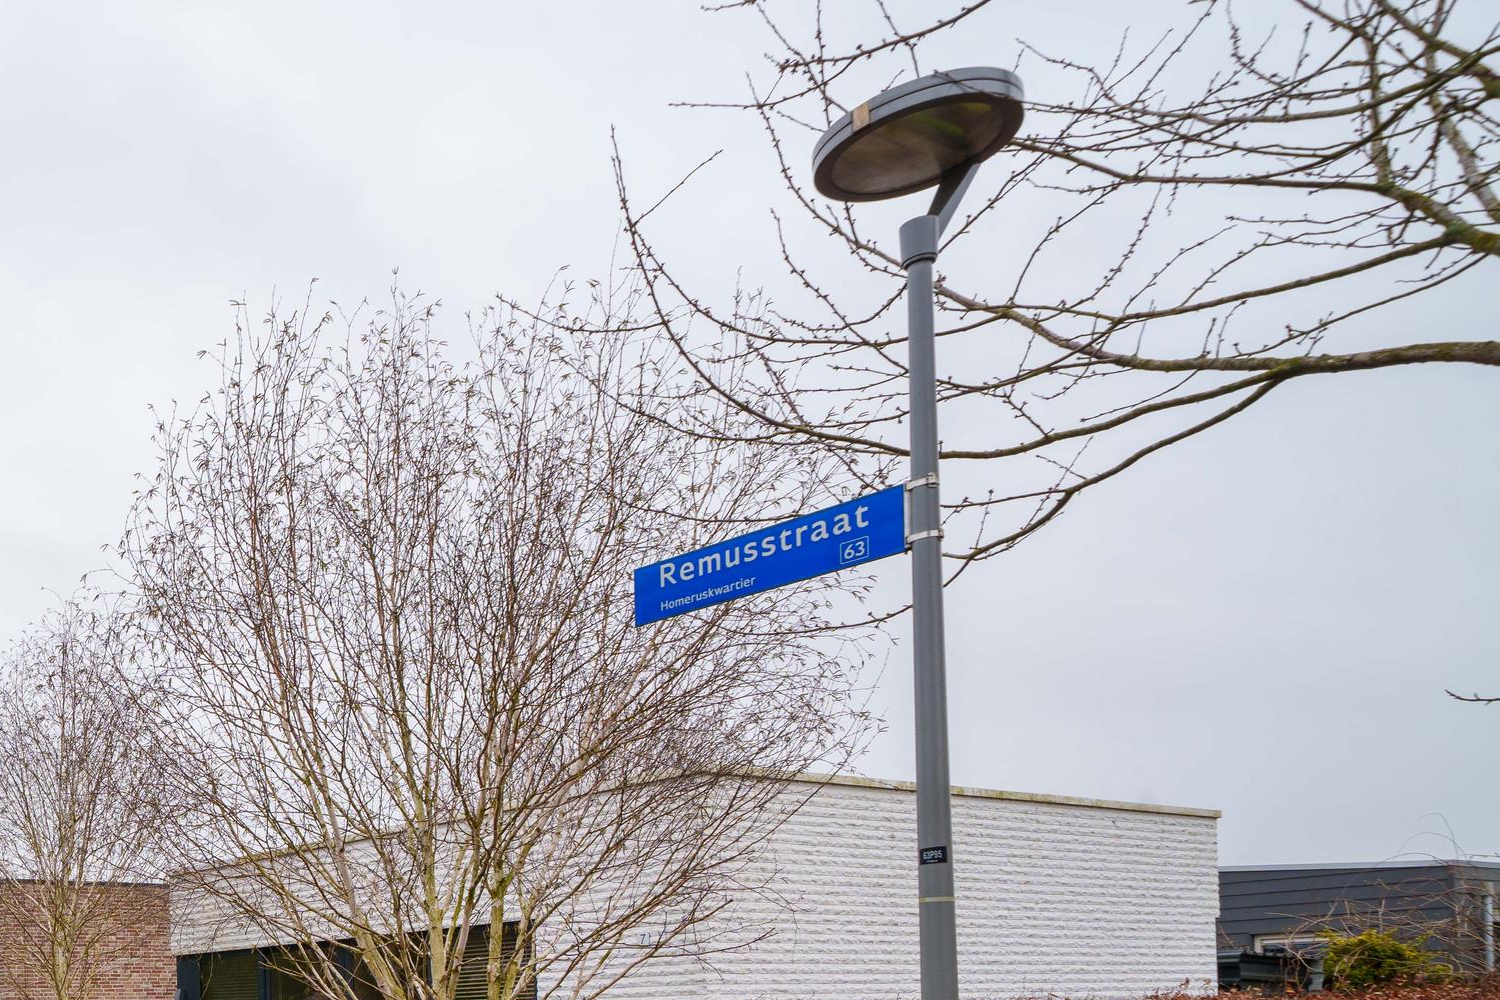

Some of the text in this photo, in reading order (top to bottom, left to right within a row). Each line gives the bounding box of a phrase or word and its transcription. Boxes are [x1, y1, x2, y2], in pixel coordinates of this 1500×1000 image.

[659, 504, 869, 588] Remusstraat
[844, 541, 865, 559] 63
[660, 577, 756, 611] Homeruskwartier
[639, 933, 646, 944] 7
